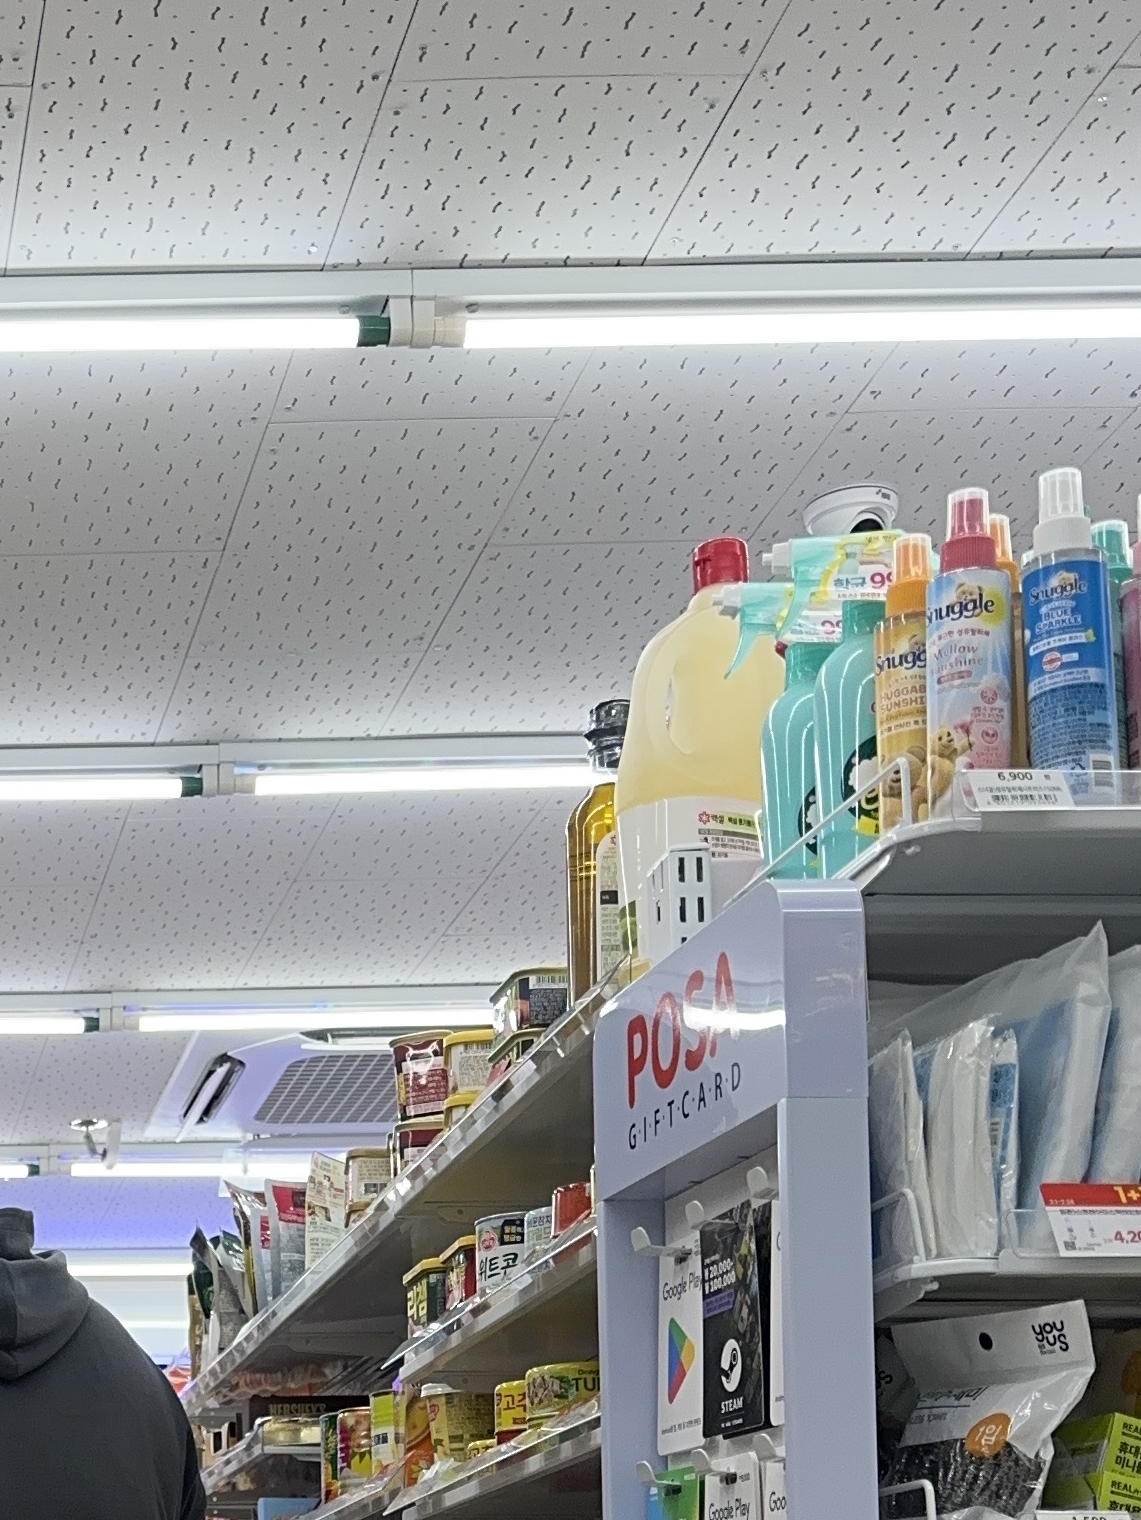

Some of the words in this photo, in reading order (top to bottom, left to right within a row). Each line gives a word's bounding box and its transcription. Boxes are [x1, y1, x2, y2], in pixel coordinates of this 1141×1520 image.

[869, 572, 892, 589] 9
[1030, 577, 1087, 602] Snuggle
[1043, 608, 1071, 621] BLUE
[1035, 615, 1082, 635] SPARKLE
[876, 647, 926, 677] Snugg
[878, 684, 926, 702] HUGGAB
[879, 695, 926, 715] SUNSHI
[997, 771, 1033, 783] 6,900
[627, 951, 741, 1110] POSA
[1114, 1230, 1141, 1243] 4,20
[662, 1279, 687, 1302] Google
[1031, 1319, 1065, 1343] you
[1045, 1333, 1070, 1352] us
[573, 1377, 600, 1393] TU
[268, 1403, 328, 1417] HERSHEY'S
[720, 1395, 744, 1415] STEAM
[1122, 1422, 1141, 1434] REA
[1117, 1441, 1141, 1456] 휴대
[768, 1491, 787, 1513] Goo
